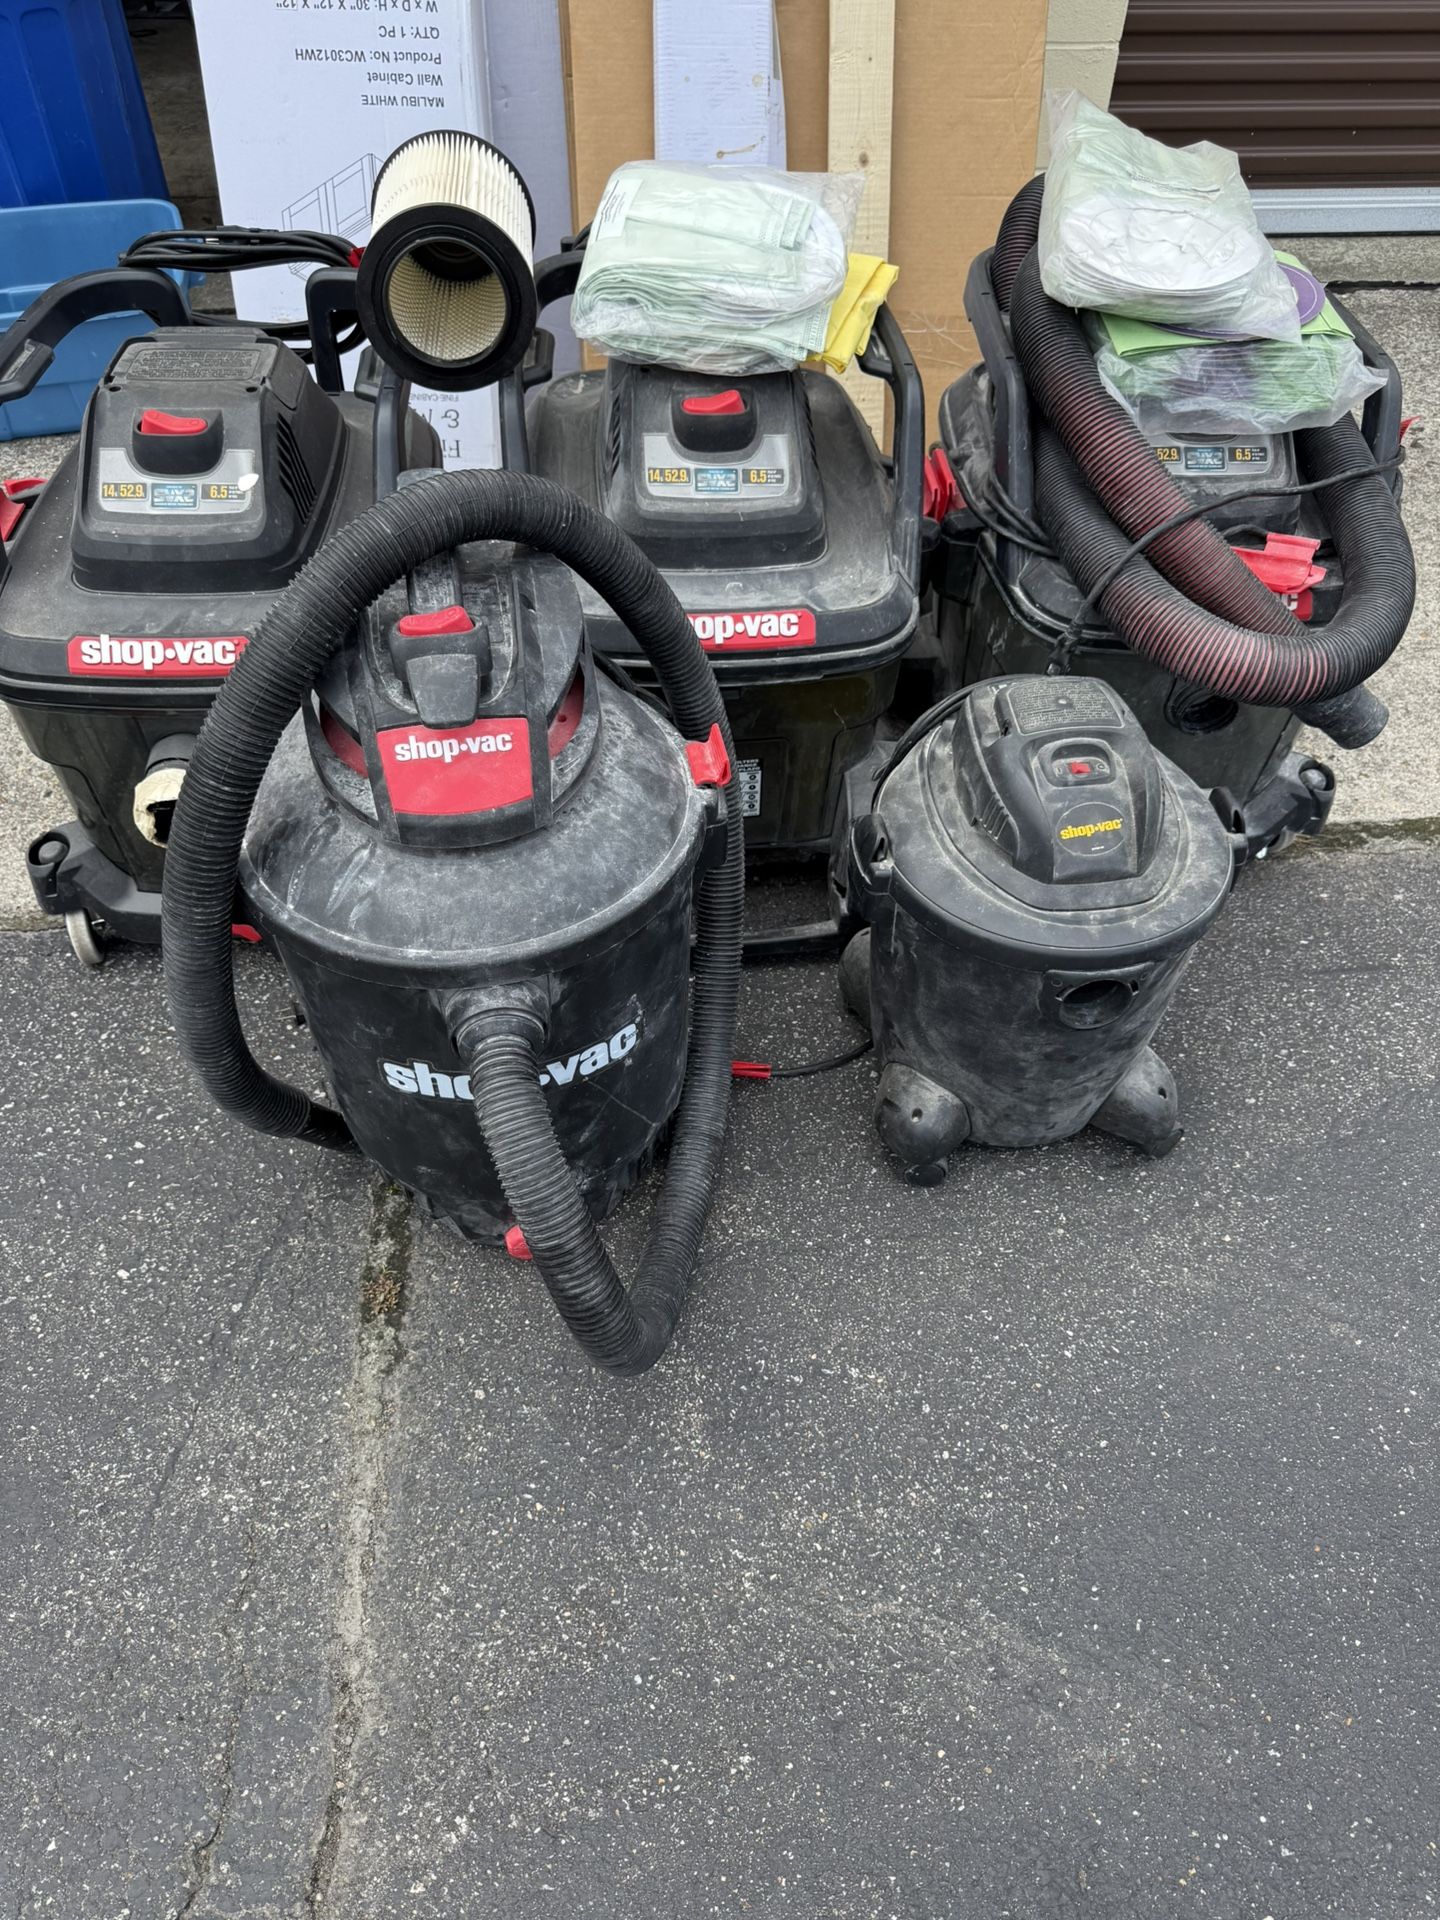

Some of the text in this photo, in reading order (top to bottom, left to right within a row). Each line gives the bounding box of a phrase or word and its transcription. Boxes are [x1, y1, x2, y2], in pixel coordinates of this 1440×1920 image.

[276, 0, 297, 9] 12"
[314, 0, 334, 10] 12"
[350, 0, 371, 11] 30"
[374, 0, 387, 12] H:
[402, 0, 411, 12] D
[425, 0, 438, 13] W
[378, 25, 440, 40] QTY: 1 PC
[295, 48, 442, 65] Product No: WC3012WH
[367, 71, 443, 87] Wall Cabinet
[361, 94, 445, 108] MALIBU WHITE
[440, 408, 460, 429] &
[1235, 448, 1252, 461] 6.5
[750, 469, 768, 483] 6.5
[209, 484, 228, 498] 6.5
